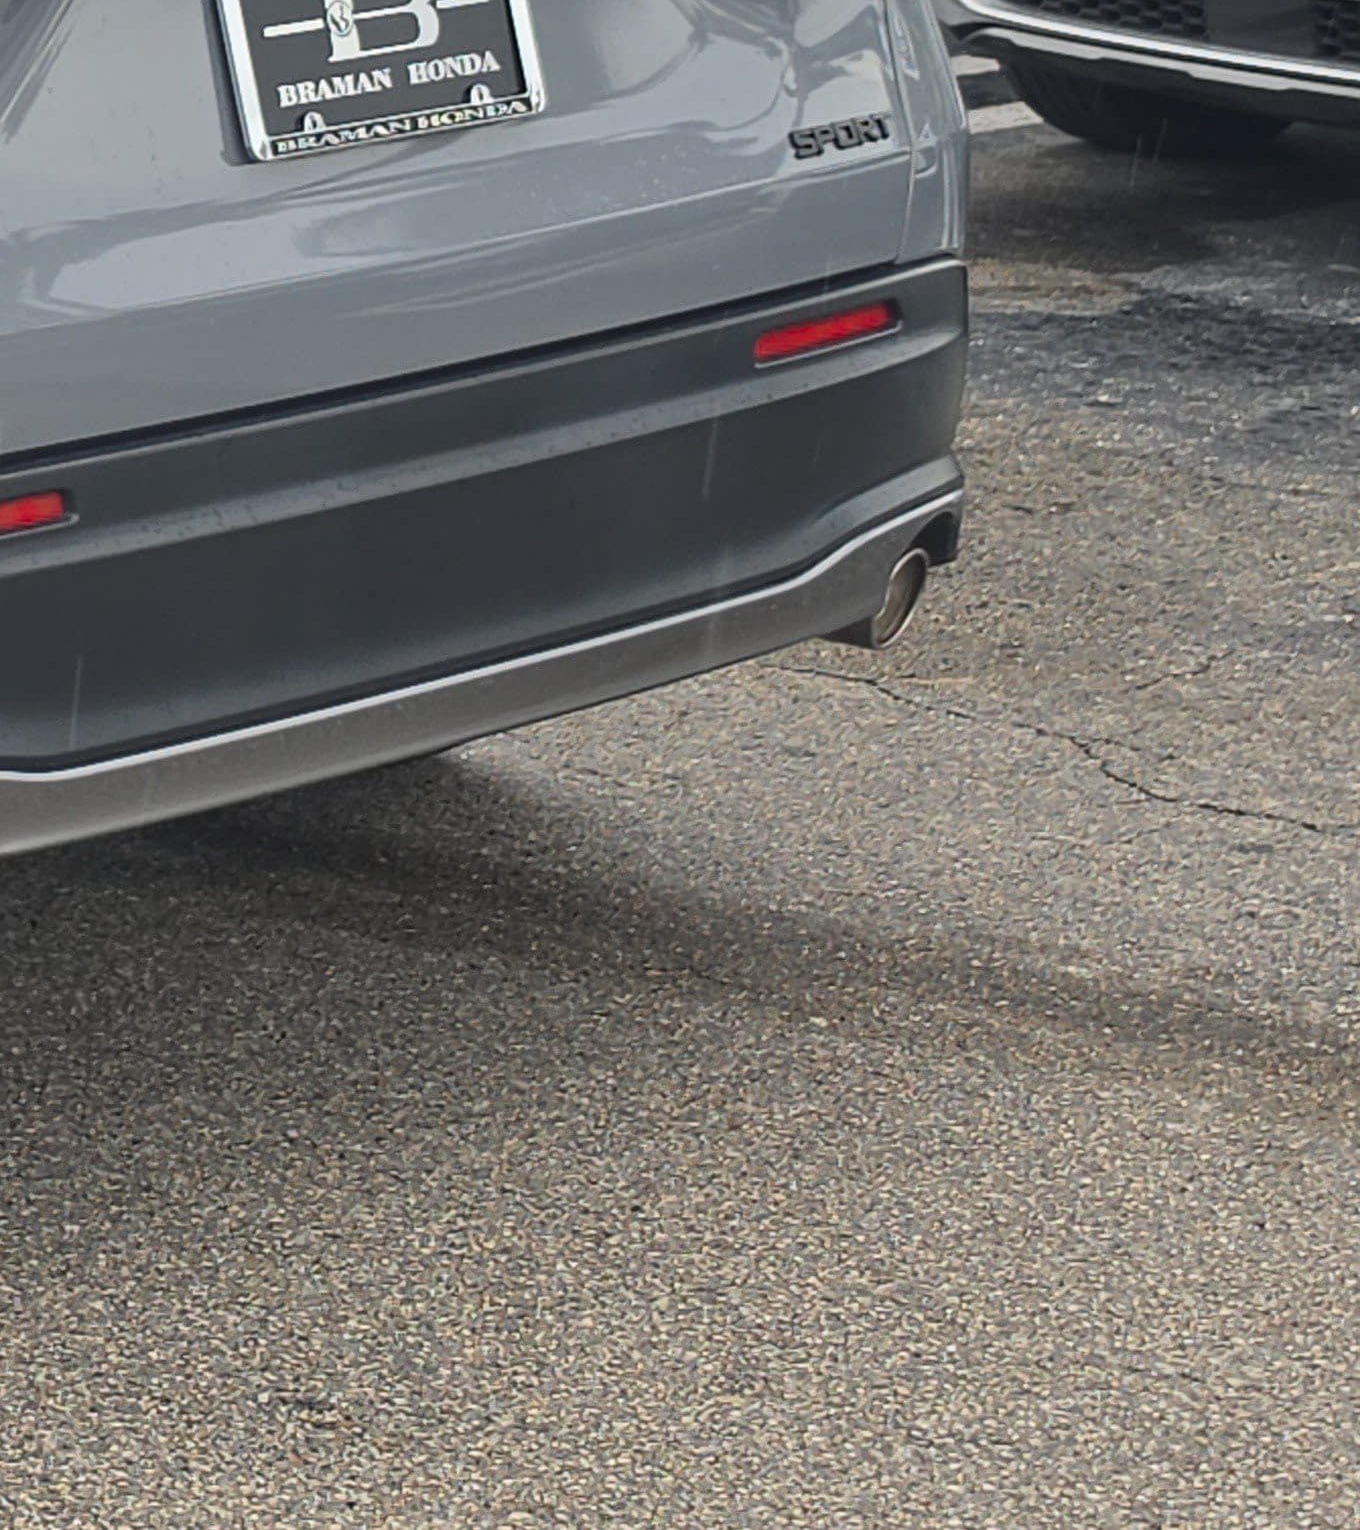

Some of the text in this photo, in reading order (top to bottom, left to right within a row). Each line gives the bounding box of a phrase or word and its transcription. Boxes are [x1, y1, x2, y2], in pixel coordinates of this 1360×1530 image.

[278, 50, 501, 108] BRAMAN HONDA
[277, 100, 529, 154] BRAMAN HONDA
[788, 111, 892, 160] SPORT
